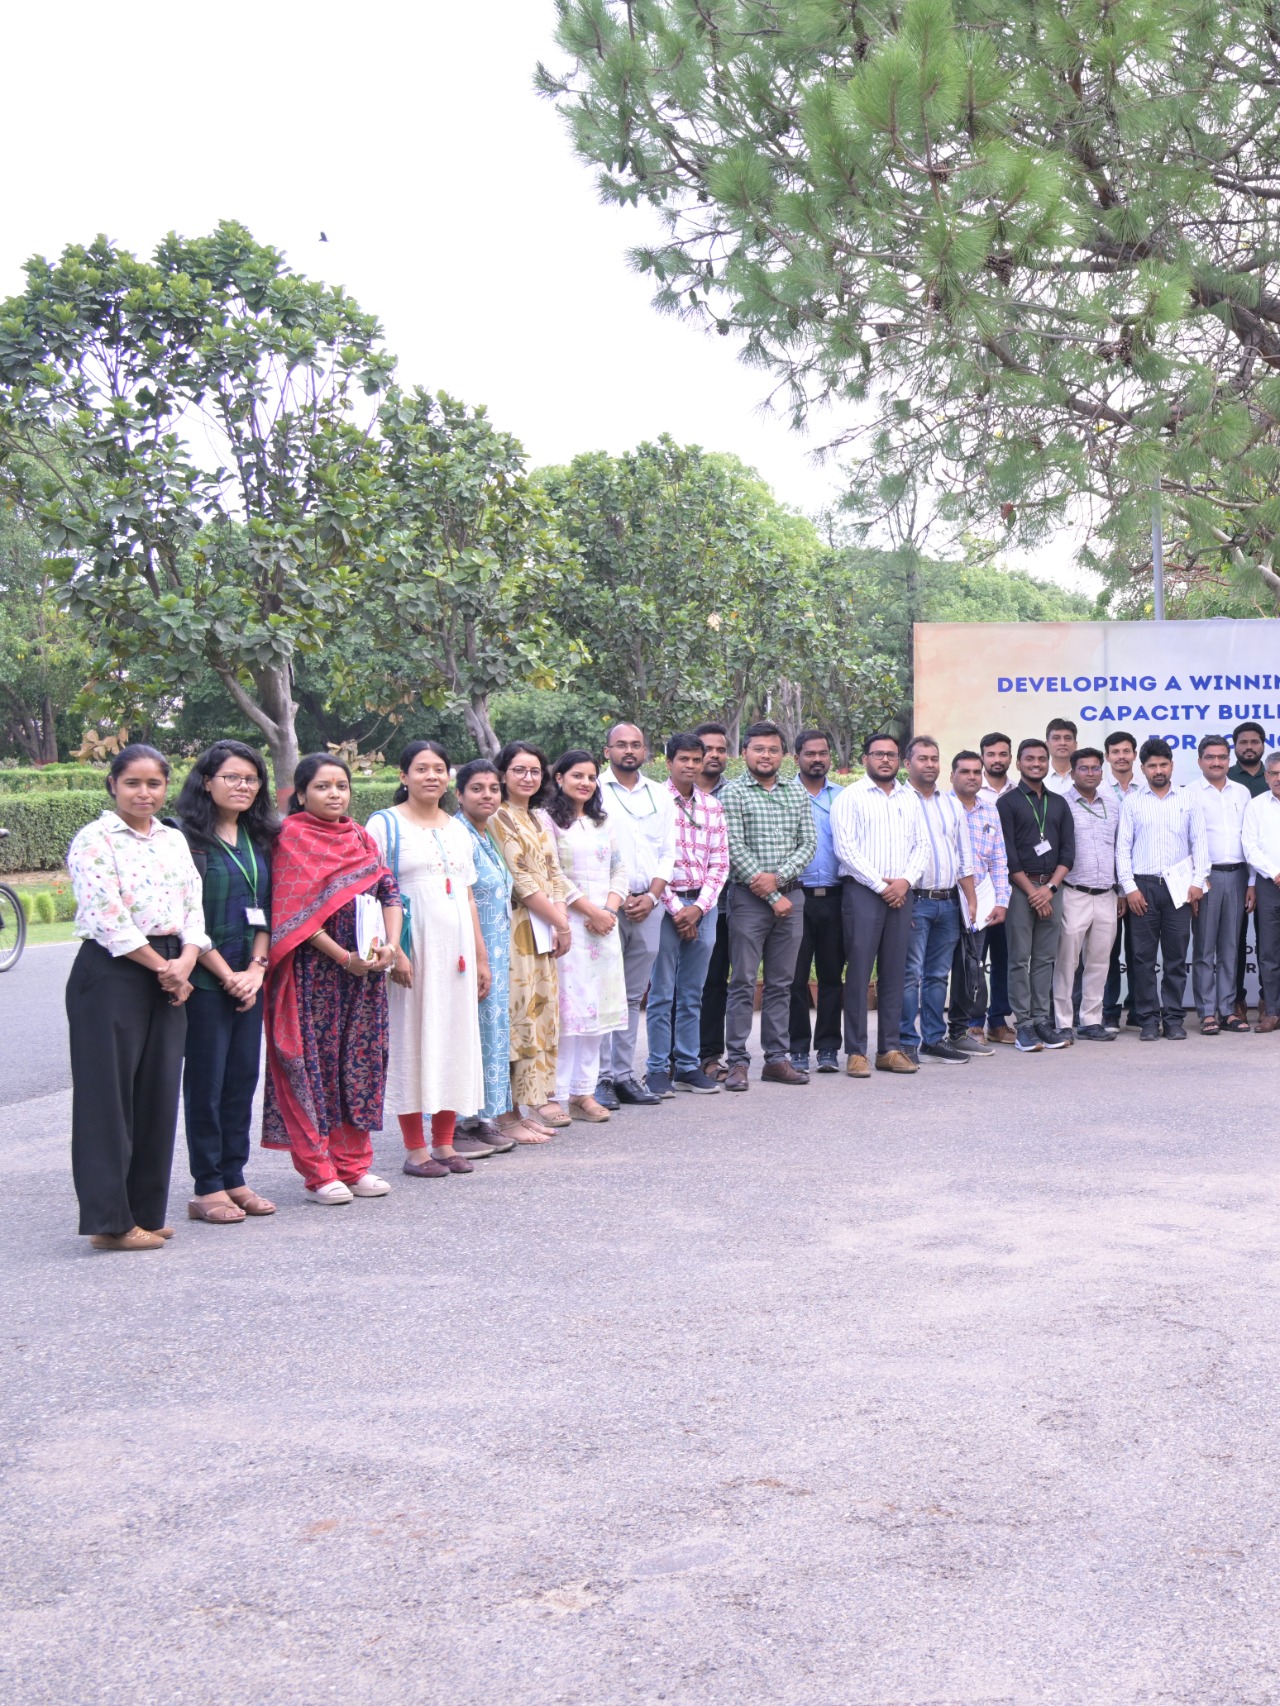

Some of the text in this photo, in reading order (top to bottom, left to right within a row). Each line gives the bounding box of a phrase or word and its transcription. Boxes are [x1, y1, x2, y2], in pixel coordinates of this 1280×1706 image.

[997, 675, 1157, 693] DEVELOPING
[1164, 676, 1182, 691] A
[1079, 705, 1210, 721] CAPACITY
